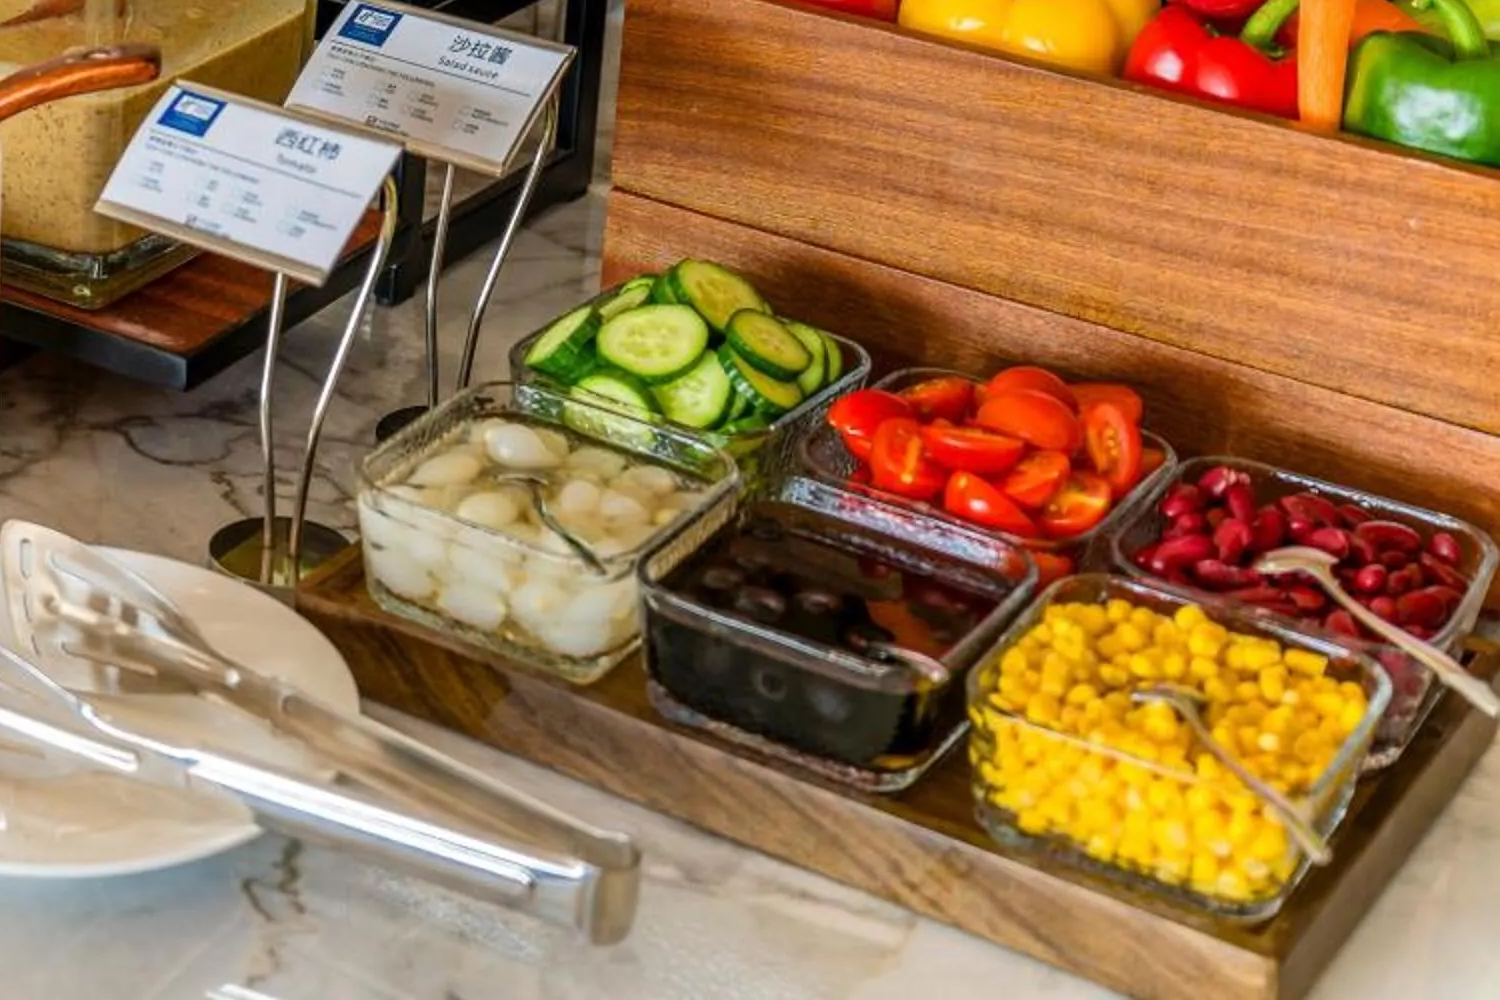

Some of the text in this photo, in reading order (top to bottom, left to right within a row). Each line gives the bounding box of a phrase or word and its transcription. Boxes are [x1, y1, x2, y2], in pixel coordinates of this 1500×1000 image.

[438, 55, 468, 71] Salad
[275, 128, 343, 160] 西红柿
